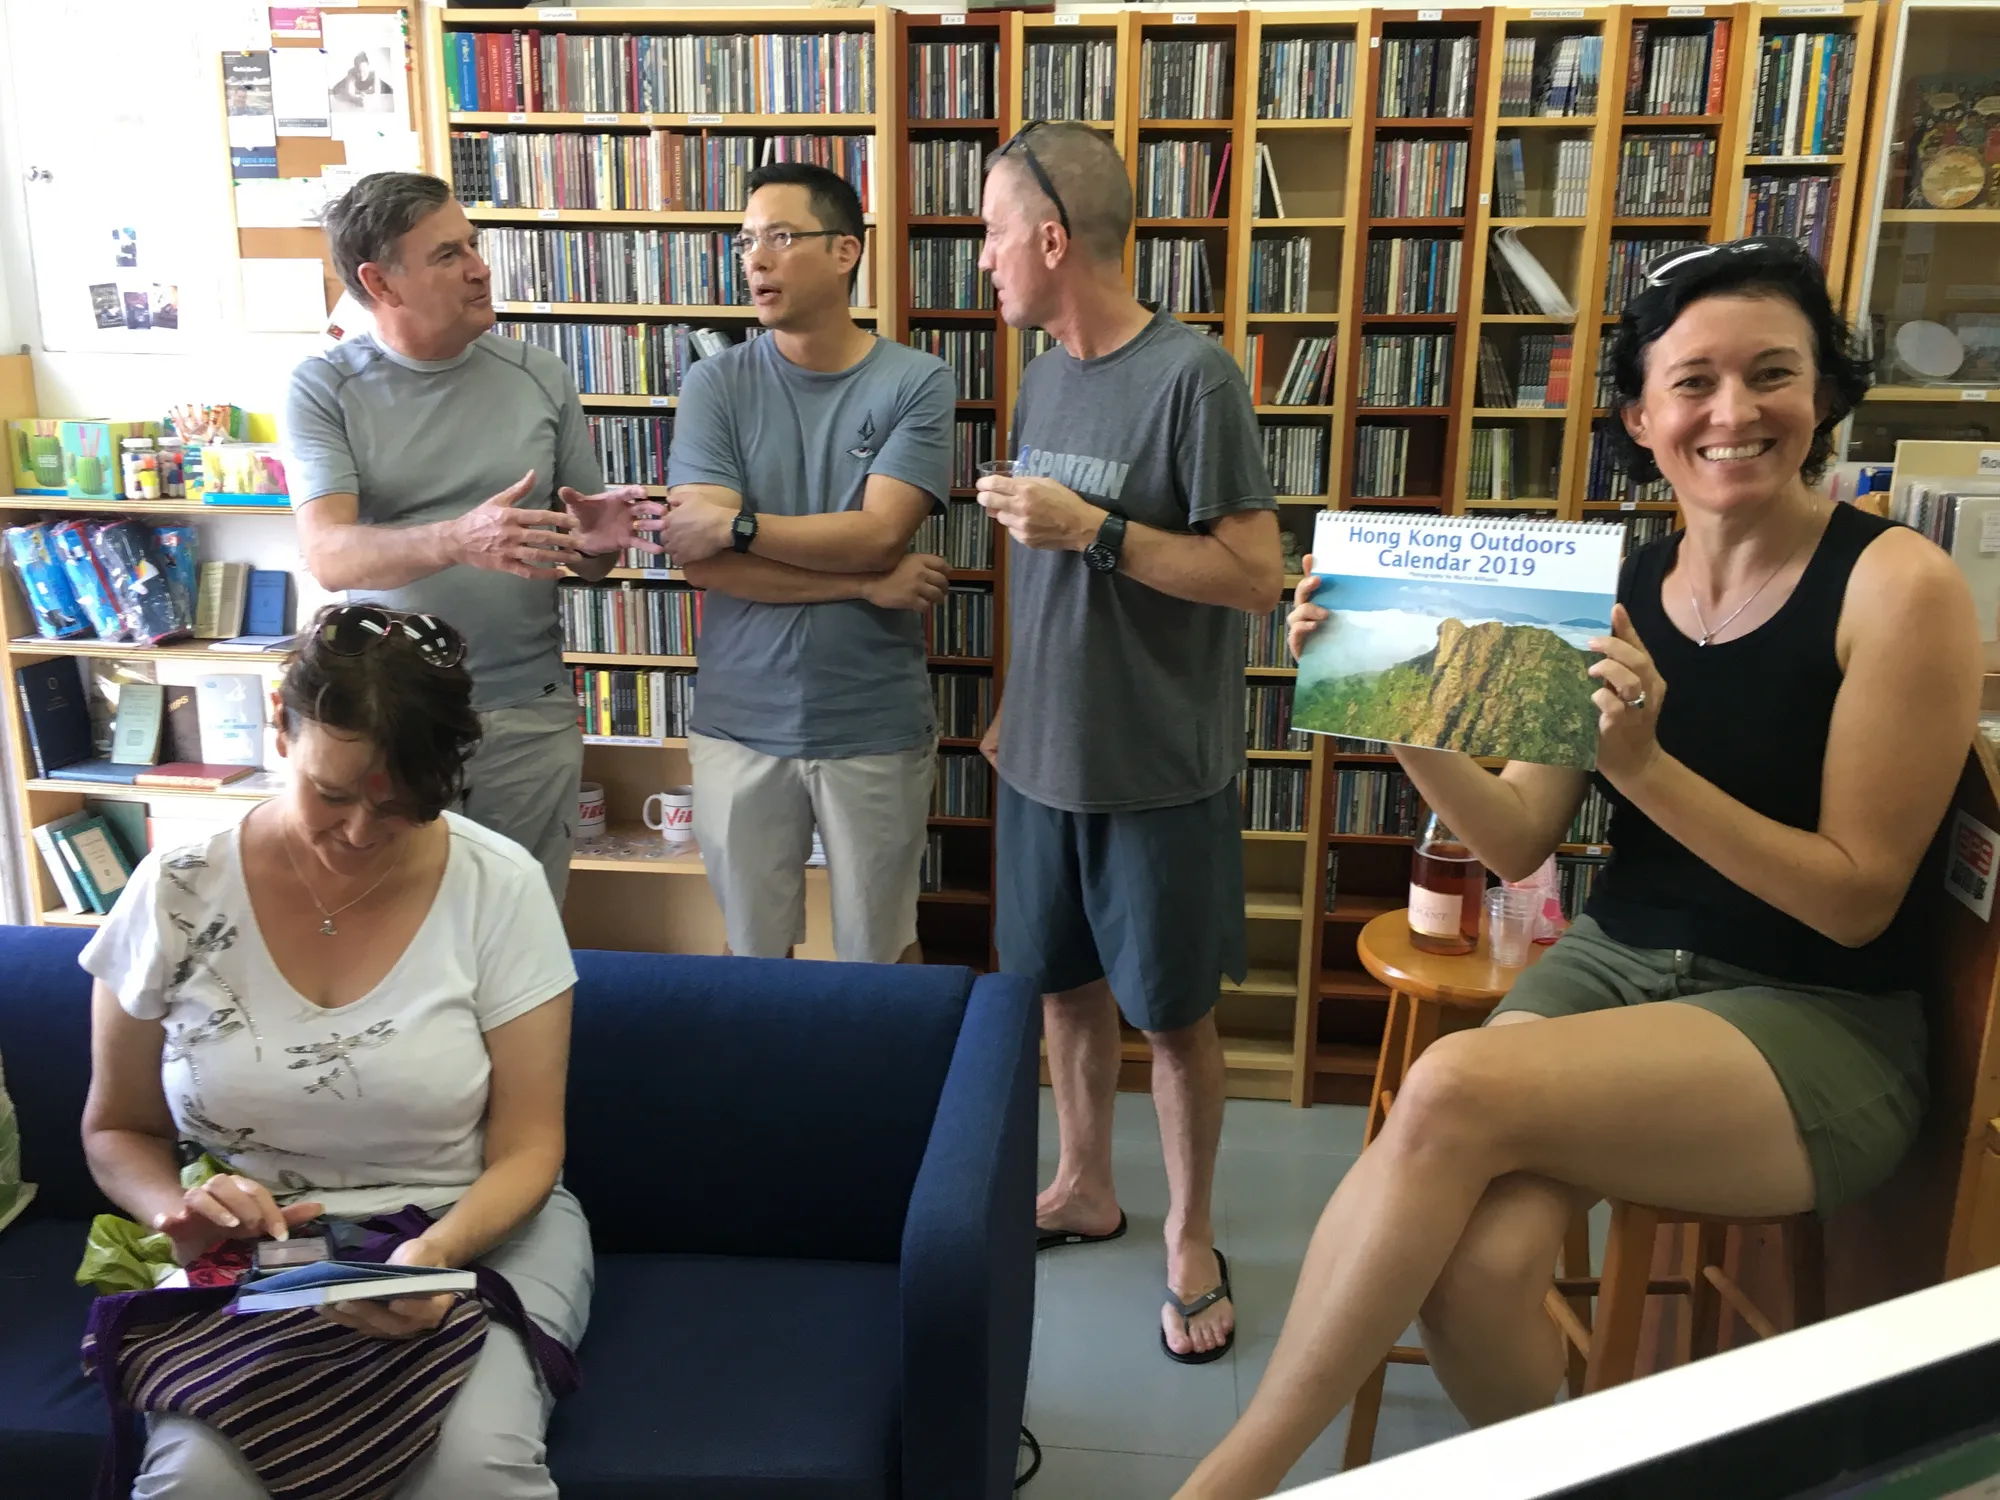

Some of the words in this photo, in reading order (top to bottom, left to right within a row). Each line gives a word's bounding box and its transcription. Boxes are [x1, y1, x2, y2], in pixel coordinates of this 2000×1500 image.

[1715, 48, 1725, 70] Life
[1711, 86, 1722, 98] Pi
[1029, 449, 1129, 500] SPARTAN
[1349, 526, 1400, 547] Hong
[1408, 529, 1462, 552] Kong
[1470, 532, 1577, 555] Outdoors
[1378, 549, 1471, 573] Calendar
[1478, 555, 1536, 577] 2019
